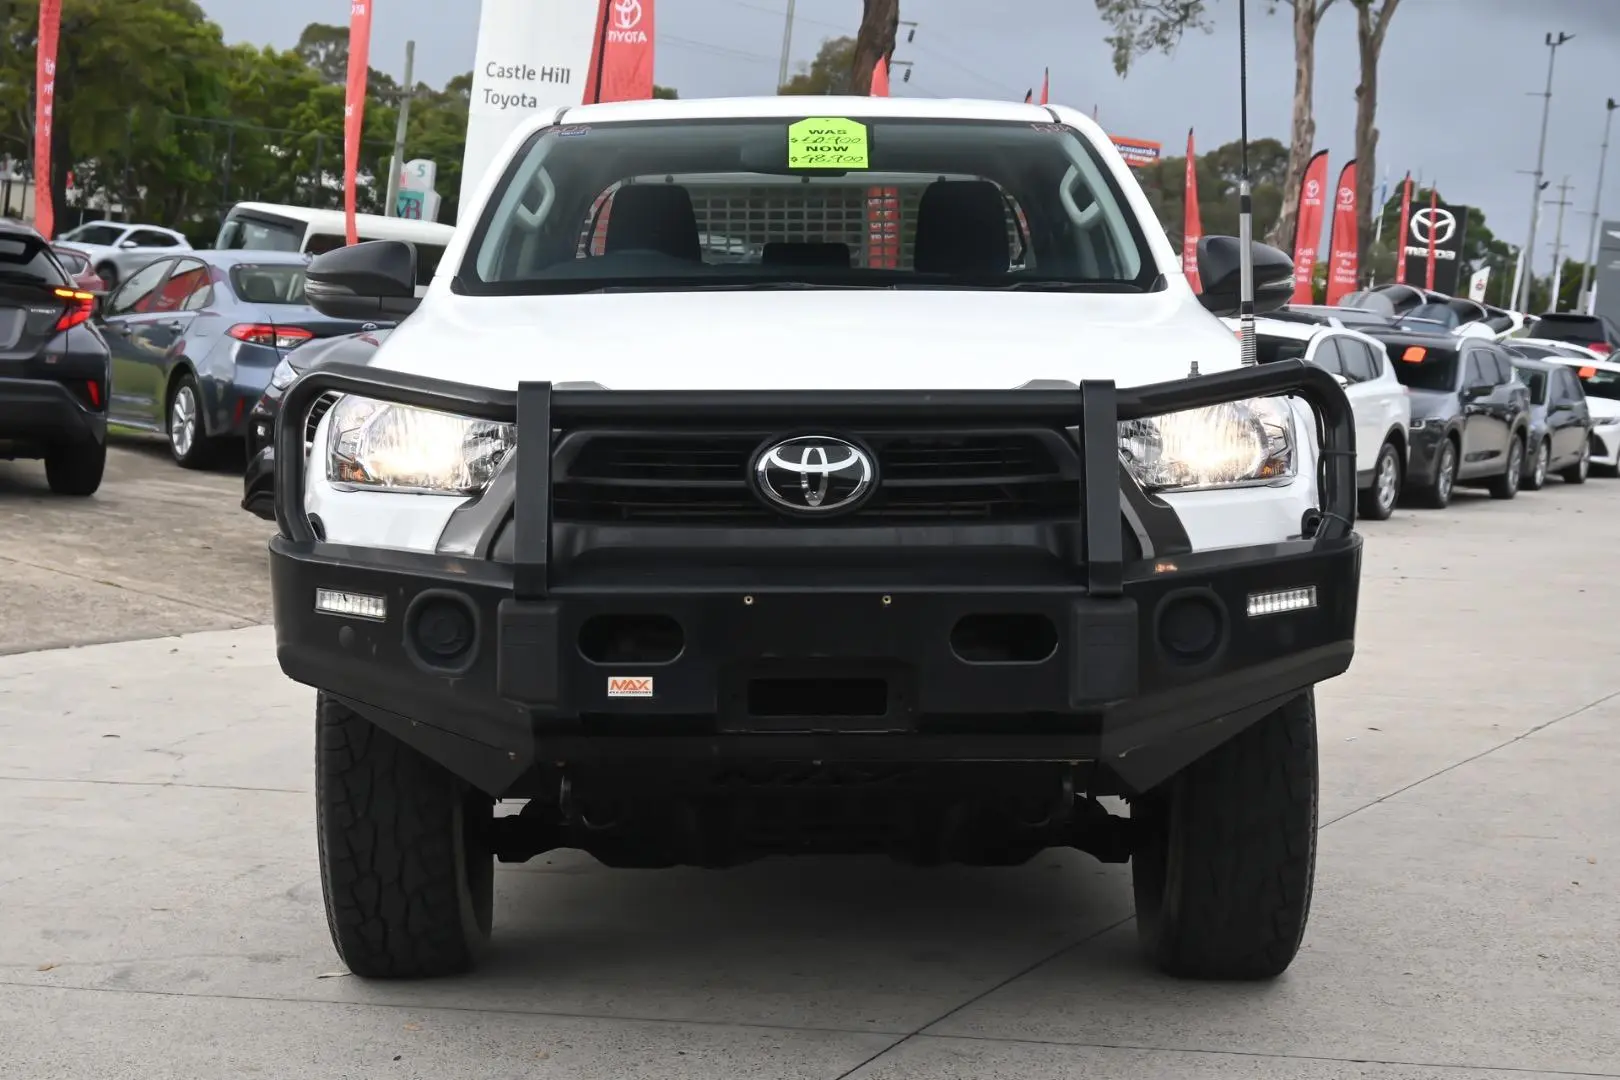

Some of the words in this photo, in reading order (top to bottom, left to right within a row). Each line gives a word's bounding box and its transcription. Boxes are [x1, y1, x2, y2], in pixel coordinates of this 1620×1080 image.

[486, 61, 536, 81] Castle
[540, 66, 571, 84] Hill
[484, 88, 537, 110] Toyota
[610, 679, 650, 691] MAX
